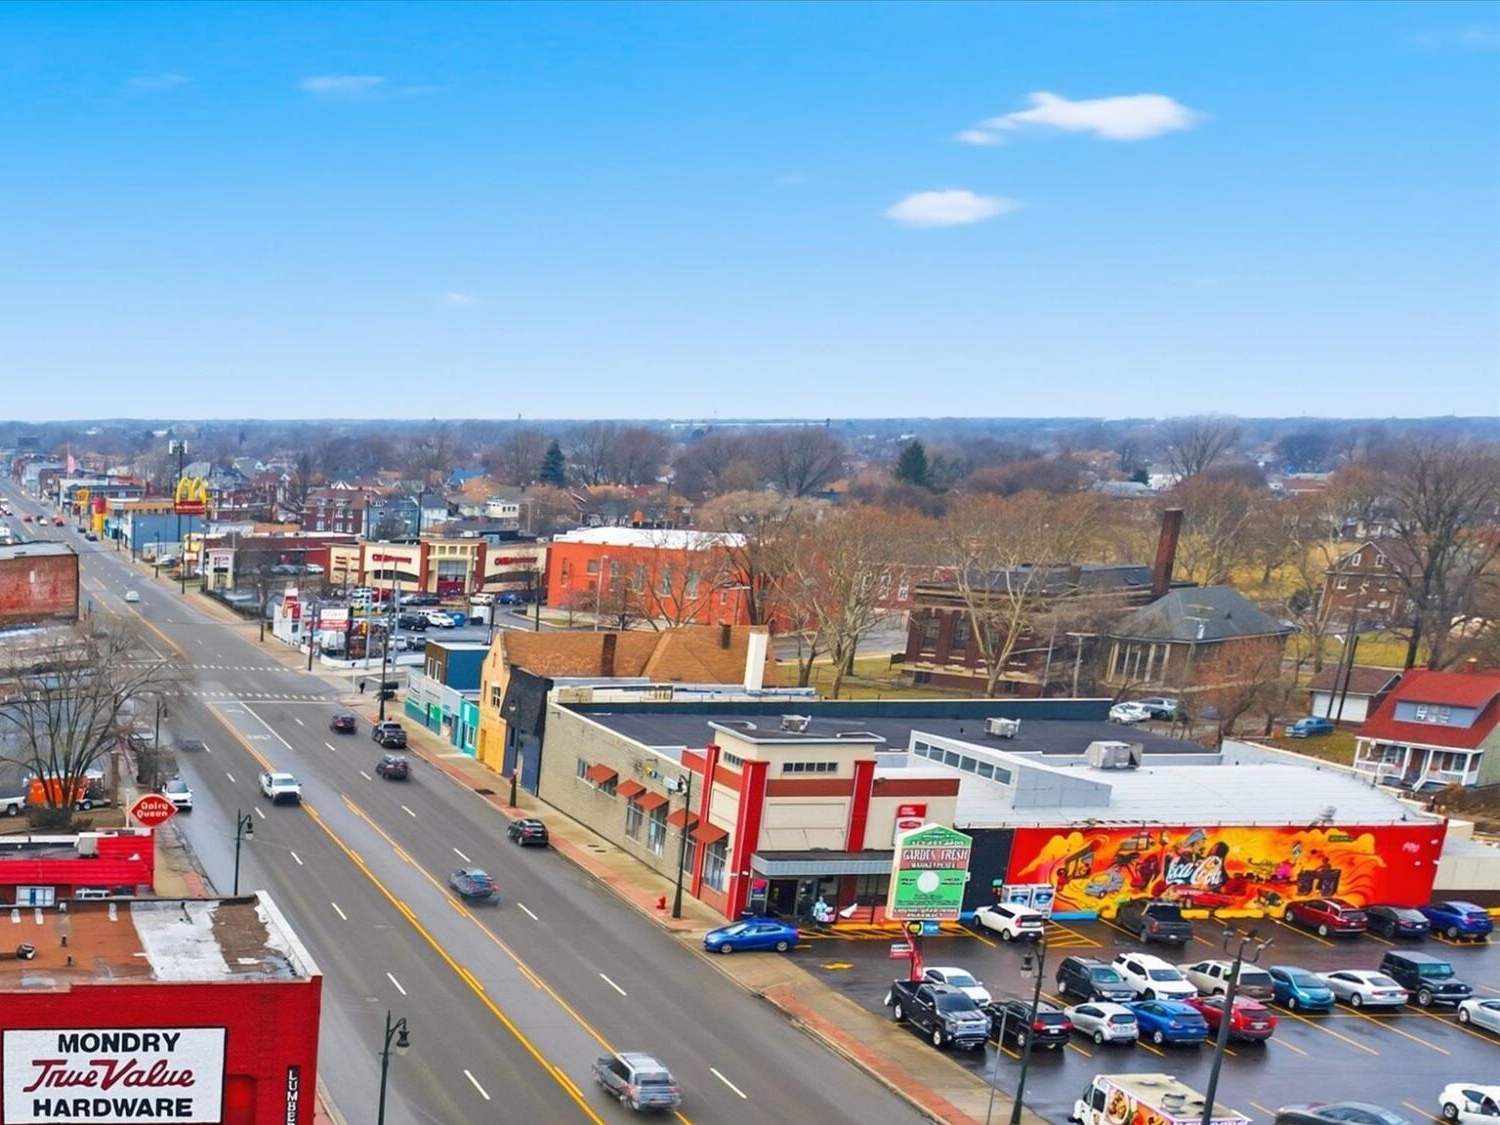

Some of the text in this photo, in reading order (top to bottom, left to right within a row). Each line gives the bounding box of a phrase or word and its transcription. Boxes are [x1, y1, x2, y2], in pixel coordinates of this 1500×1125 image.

[141, 801, 168, 811] Dairy
[137, 810, 168, 818] Queen
[941, 849, 968, 860] FRESH
[58, 1033, 180, 1053] MONDRY
[22, 1058, 195, 1092] True Value
[33, 1098, 193, 1117] HARDWARE
